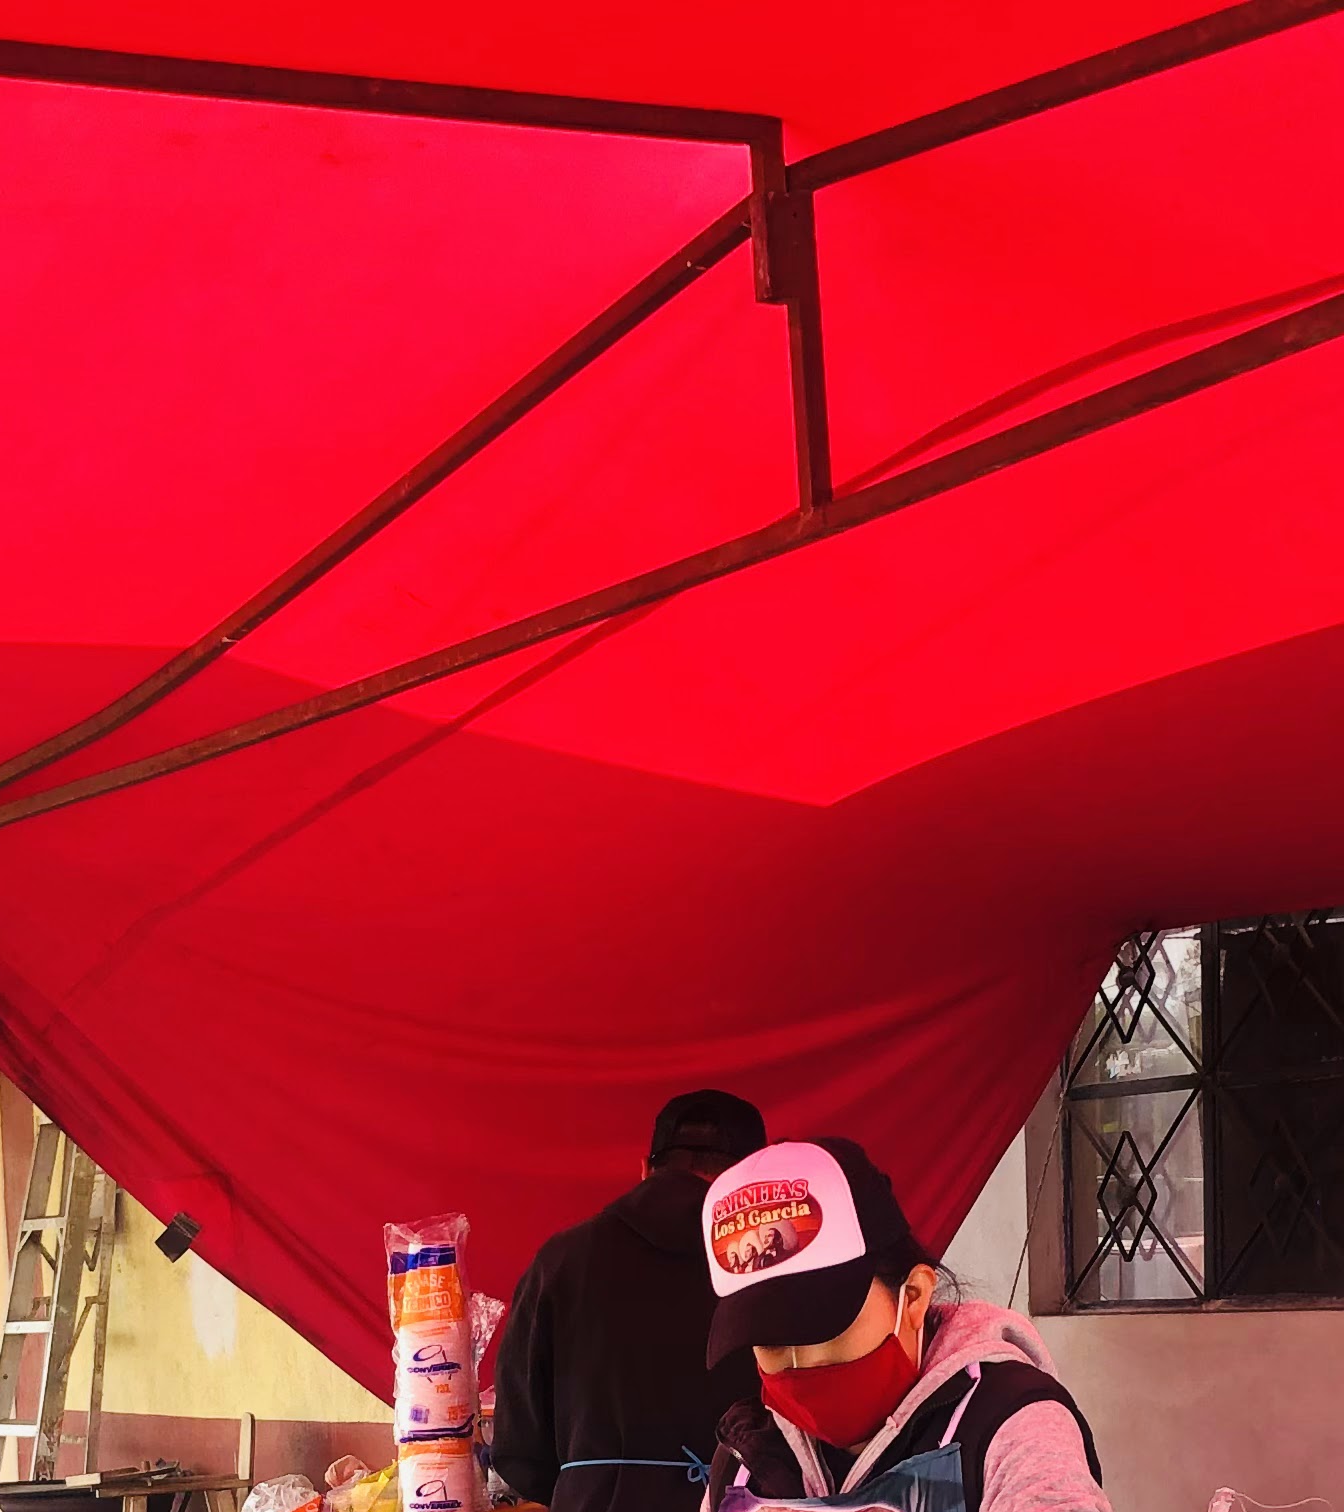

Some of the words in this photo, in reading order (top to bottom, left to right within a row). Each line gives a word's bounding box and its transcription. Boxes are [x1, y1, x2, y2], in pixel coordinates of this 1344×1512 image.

[714, 1220, 736, 1241] Los
[736, 1213, 746, 1231] 3
[748, 1201, 812, 1227] Garcia
